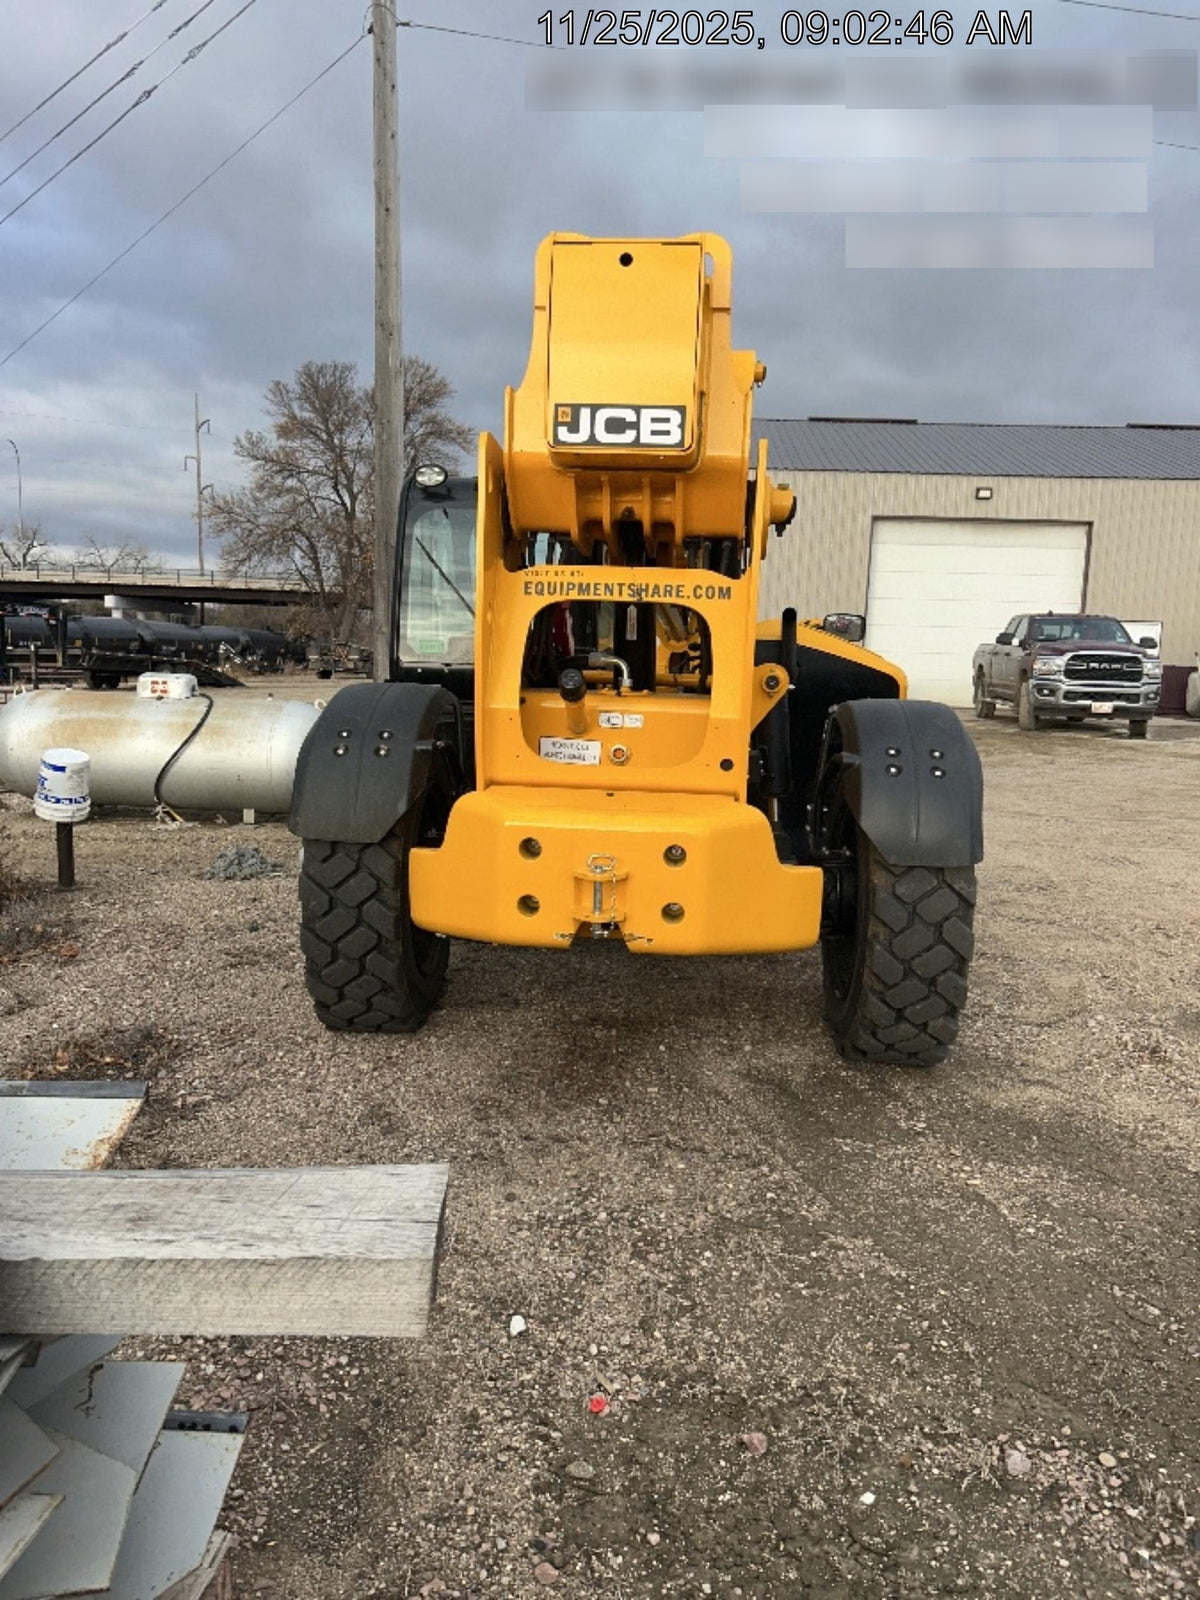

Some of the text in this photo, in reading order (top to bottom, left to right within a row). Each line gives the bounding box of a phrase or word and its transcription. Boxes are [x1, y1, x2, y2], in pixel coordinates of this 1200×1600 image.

[557, 406, 682, 445] JCB
[524, 581, 732, 600] EQUIPMENTSHARE.COM
[1089, 662, 1121, 670] RAM
